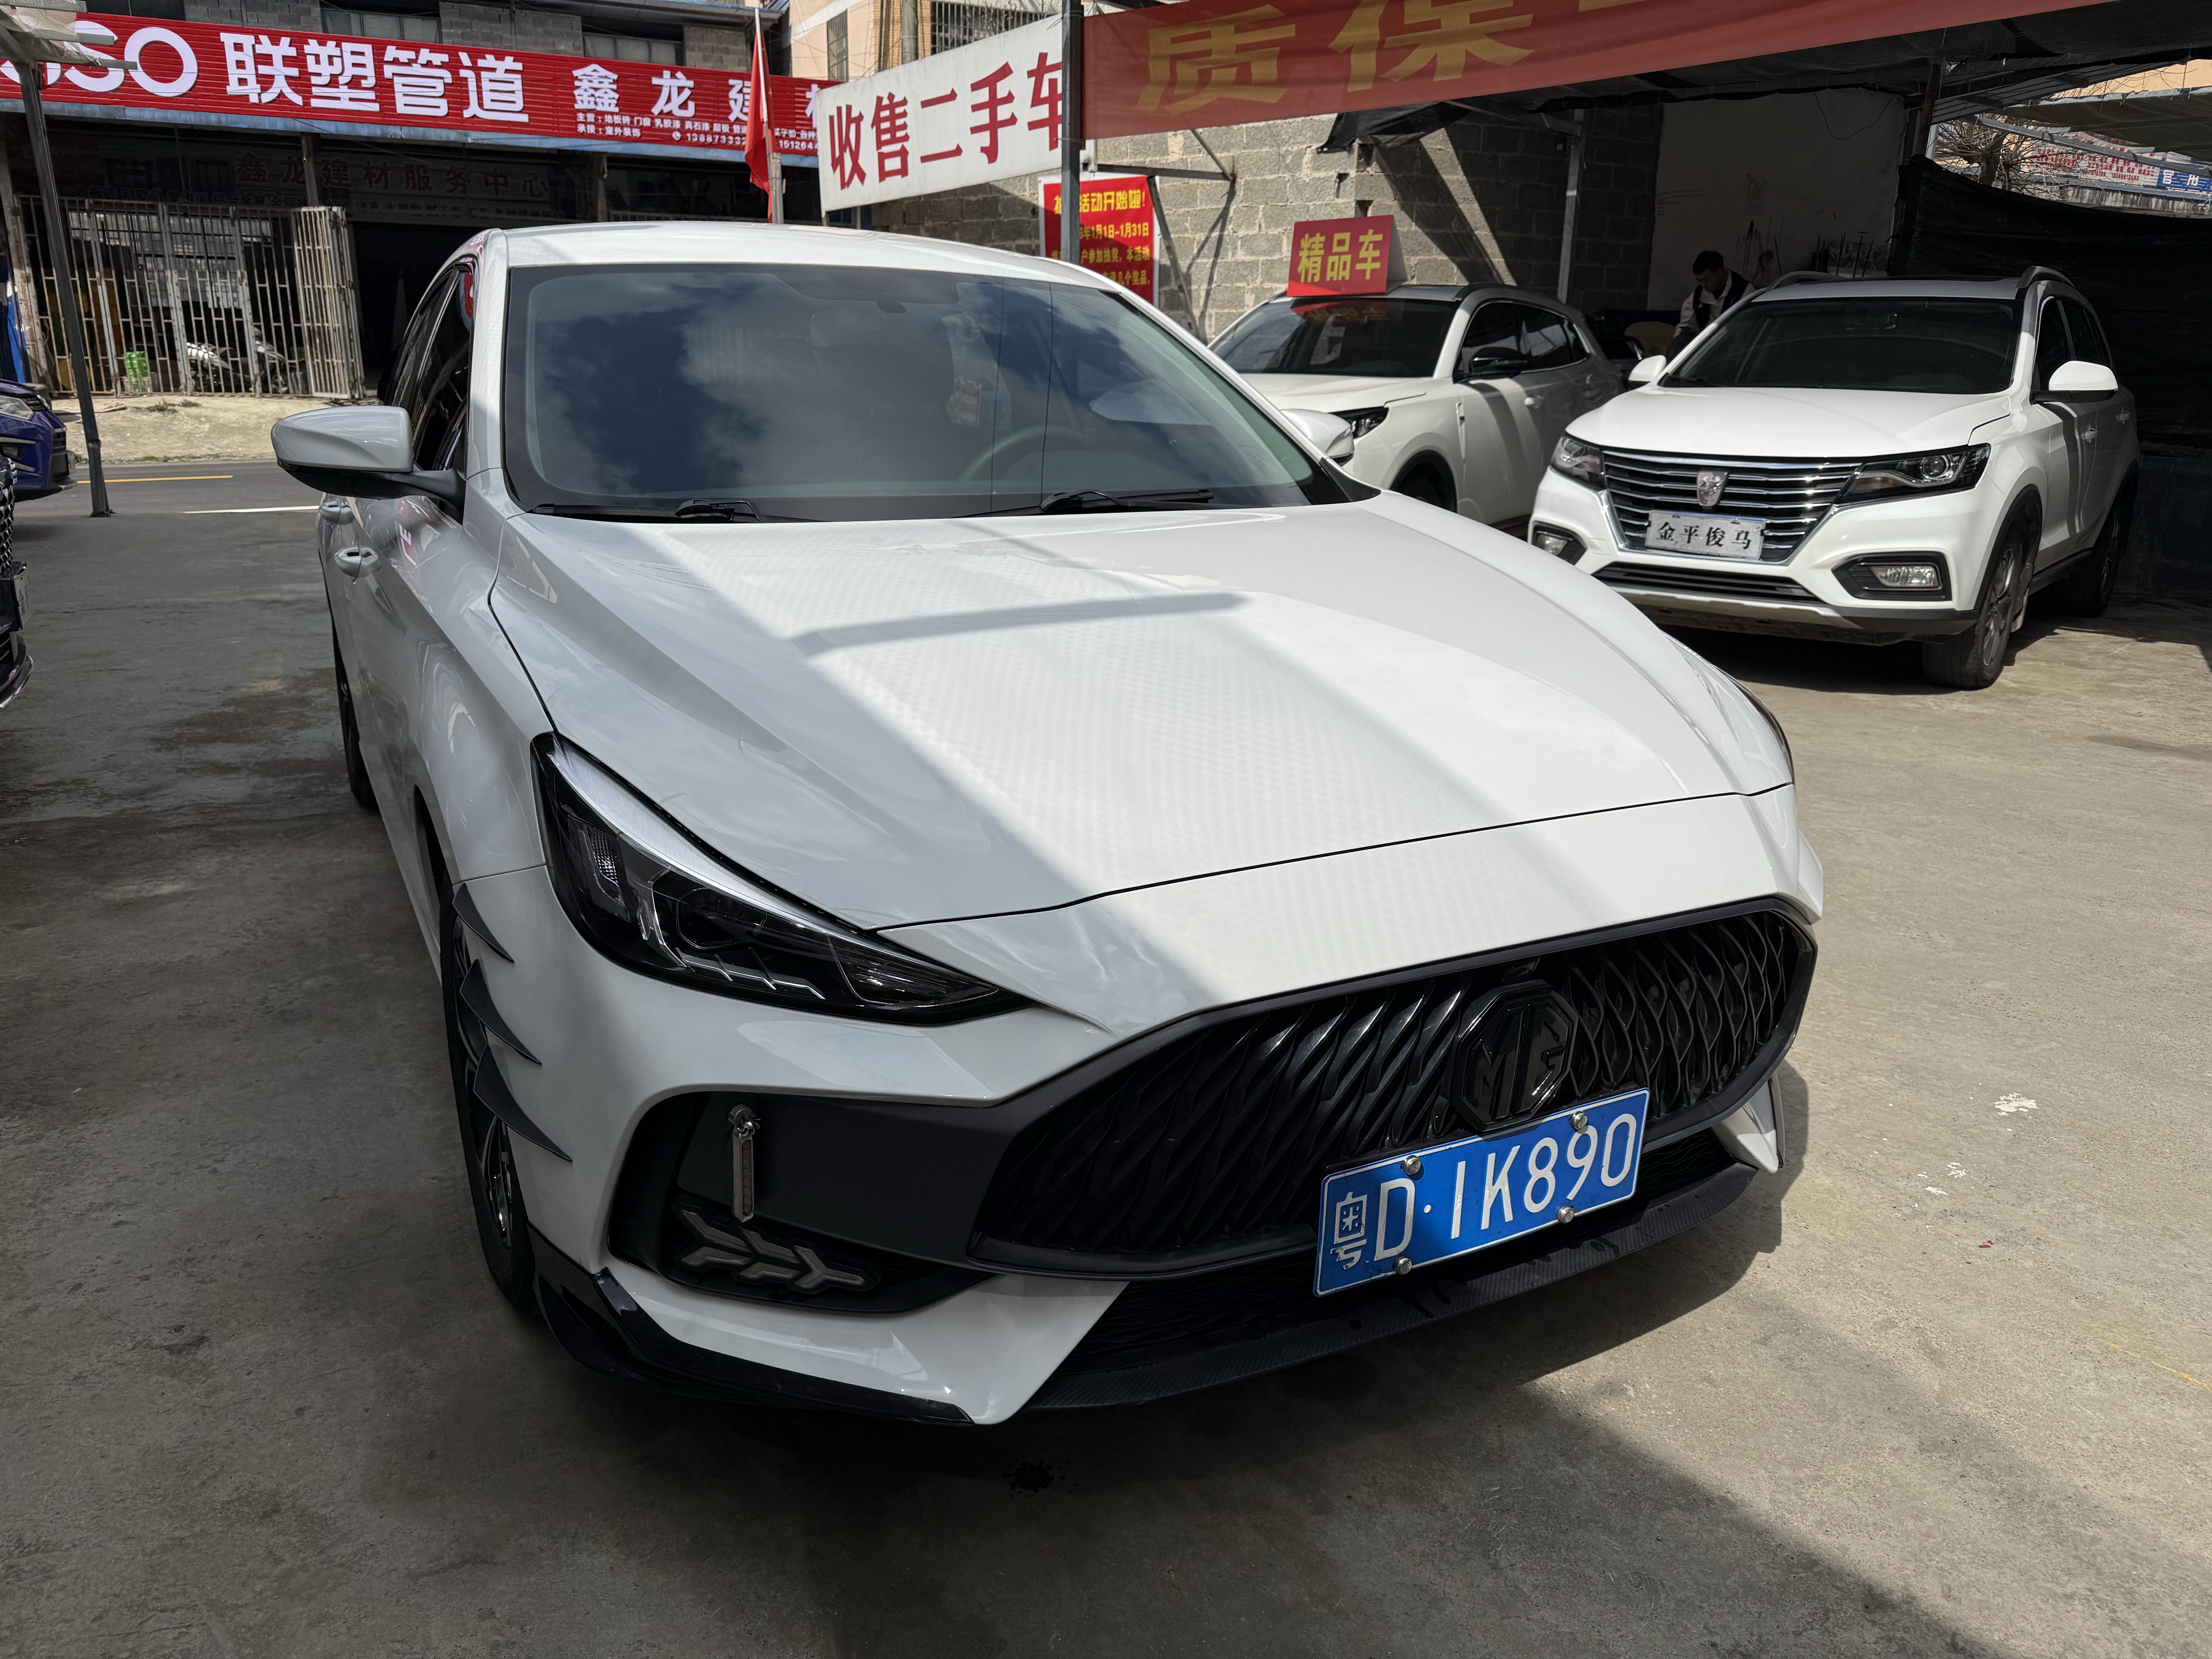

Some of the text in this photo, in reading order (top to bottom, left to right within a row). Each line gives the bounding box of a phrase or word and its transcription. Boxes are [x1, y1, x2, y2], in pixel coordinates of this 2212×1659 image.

[220, 32, 529, 123] 联塑管道
[1135, 0, 1642, 115] 质保
[829, 52, 1062, 190] 收售二手车
[236, 154, 550, 198] 鑫龙建材服务中心
[1054, 189, 1146, 214] 活动开始啦！
[1103, 270, 1150, 286] 几个奖品，
[1297, 228, 1383, 283] 精品车
[1656, 521, 1752, 550] 金平俊马
[1330, 1113, 1637, 1270] 粤D·1K890
